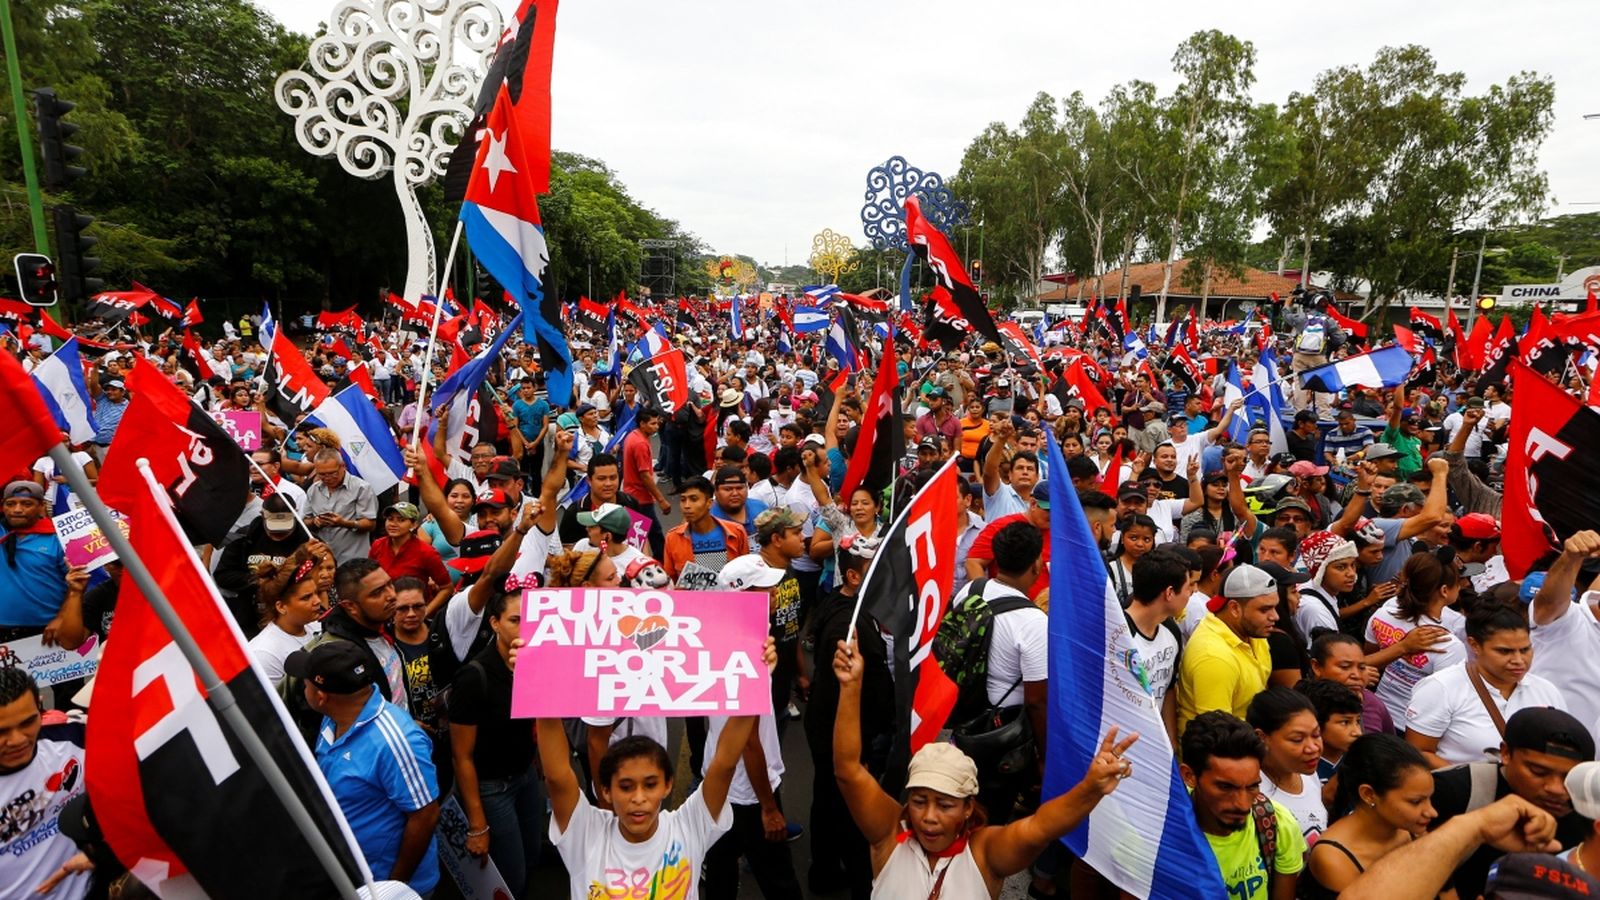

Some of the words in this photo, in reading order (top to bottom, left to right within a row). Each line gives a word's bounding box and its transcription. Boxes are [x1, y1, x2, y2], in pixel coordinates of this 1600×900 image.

[1511, 287, 1560, 297] CHINA
[694, 543, 721, 551] adidas
[526, 589, 674, 622] PURO
[584, 649, 687, 678] POR
[697, 651, 759, 679] LA
[597, 673, 740, 711] PAZ!
